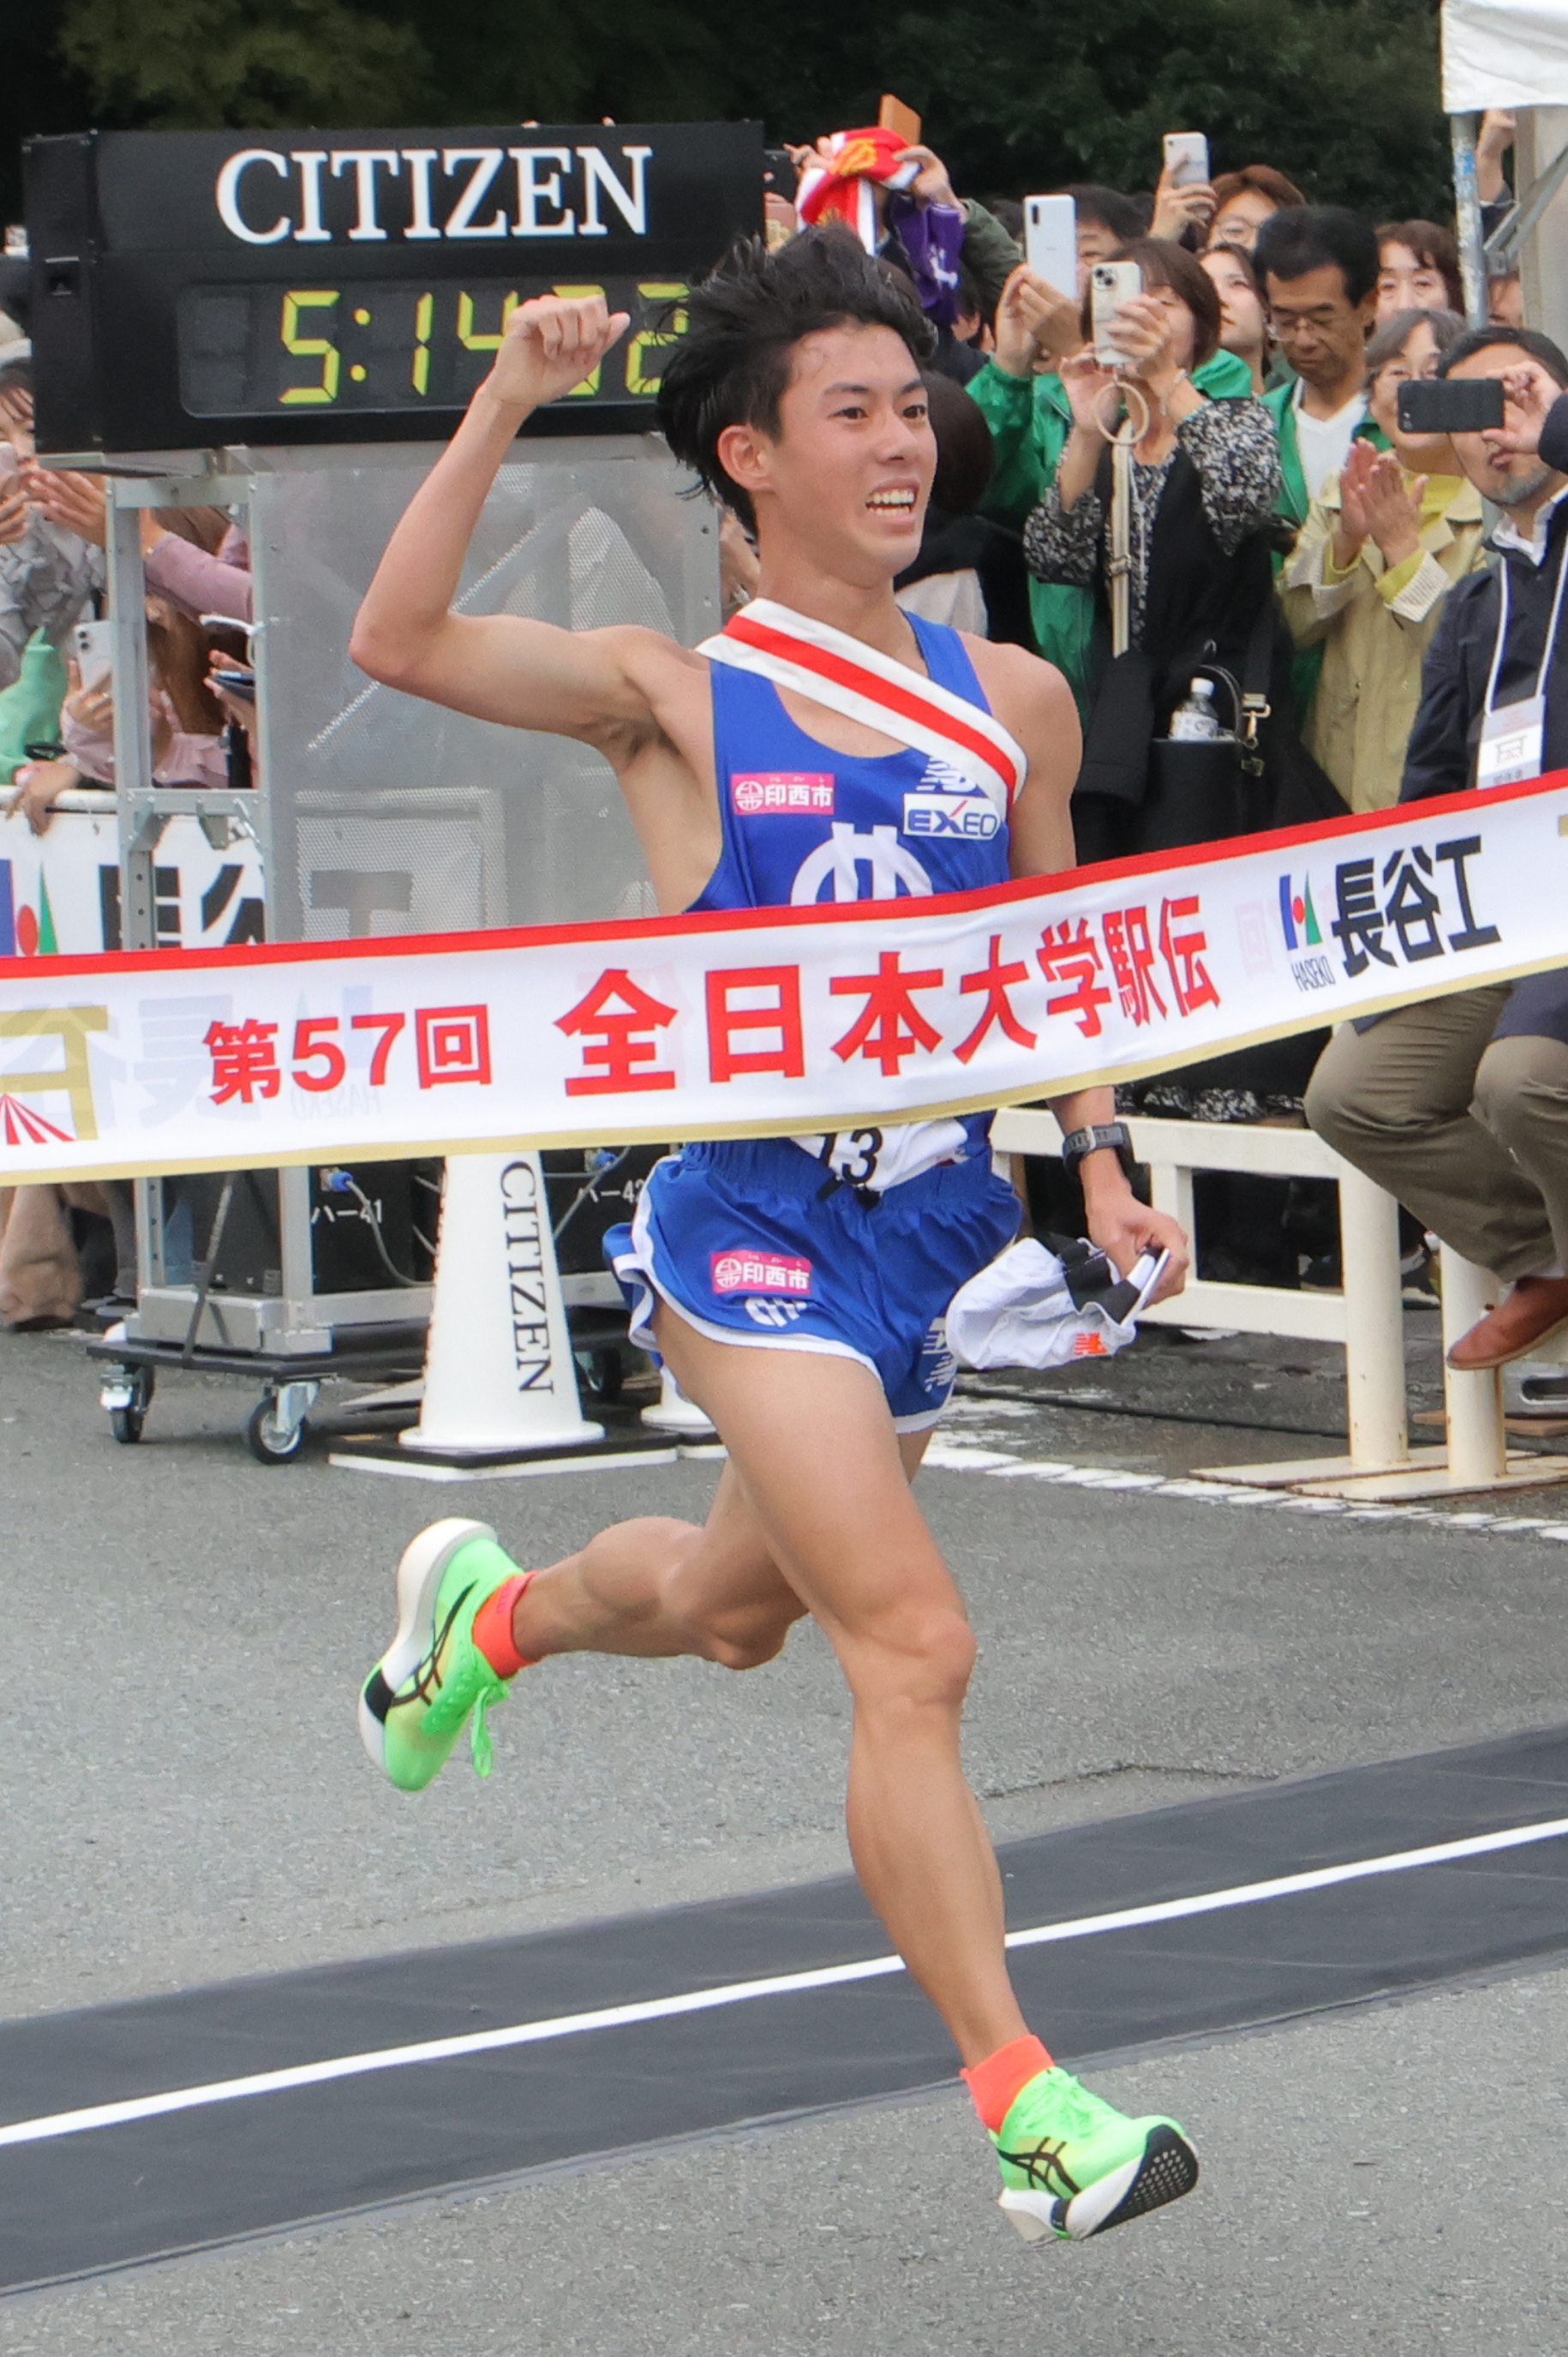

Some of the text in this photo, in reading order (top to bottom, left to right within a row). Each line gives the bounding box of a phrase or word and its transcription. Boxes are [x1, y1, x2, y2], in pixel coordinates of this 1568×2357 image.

[214, 147, 653, 244] CITIZEN
[764, 783, 835, 808] 印西市
[907, 799, 998, 837] EXEO
[1330, 834, 1503, 979] 長谷工
[203, 1005, 492, 1105] 第57回
[553, 895, 1221, 1097] 全日本大学駅伝
[1290, 955, 1337, 993] HASEKO
[500, 1161, 554, 1396] CITIZEN
[742, 1262, 810, 1290] 印西市
